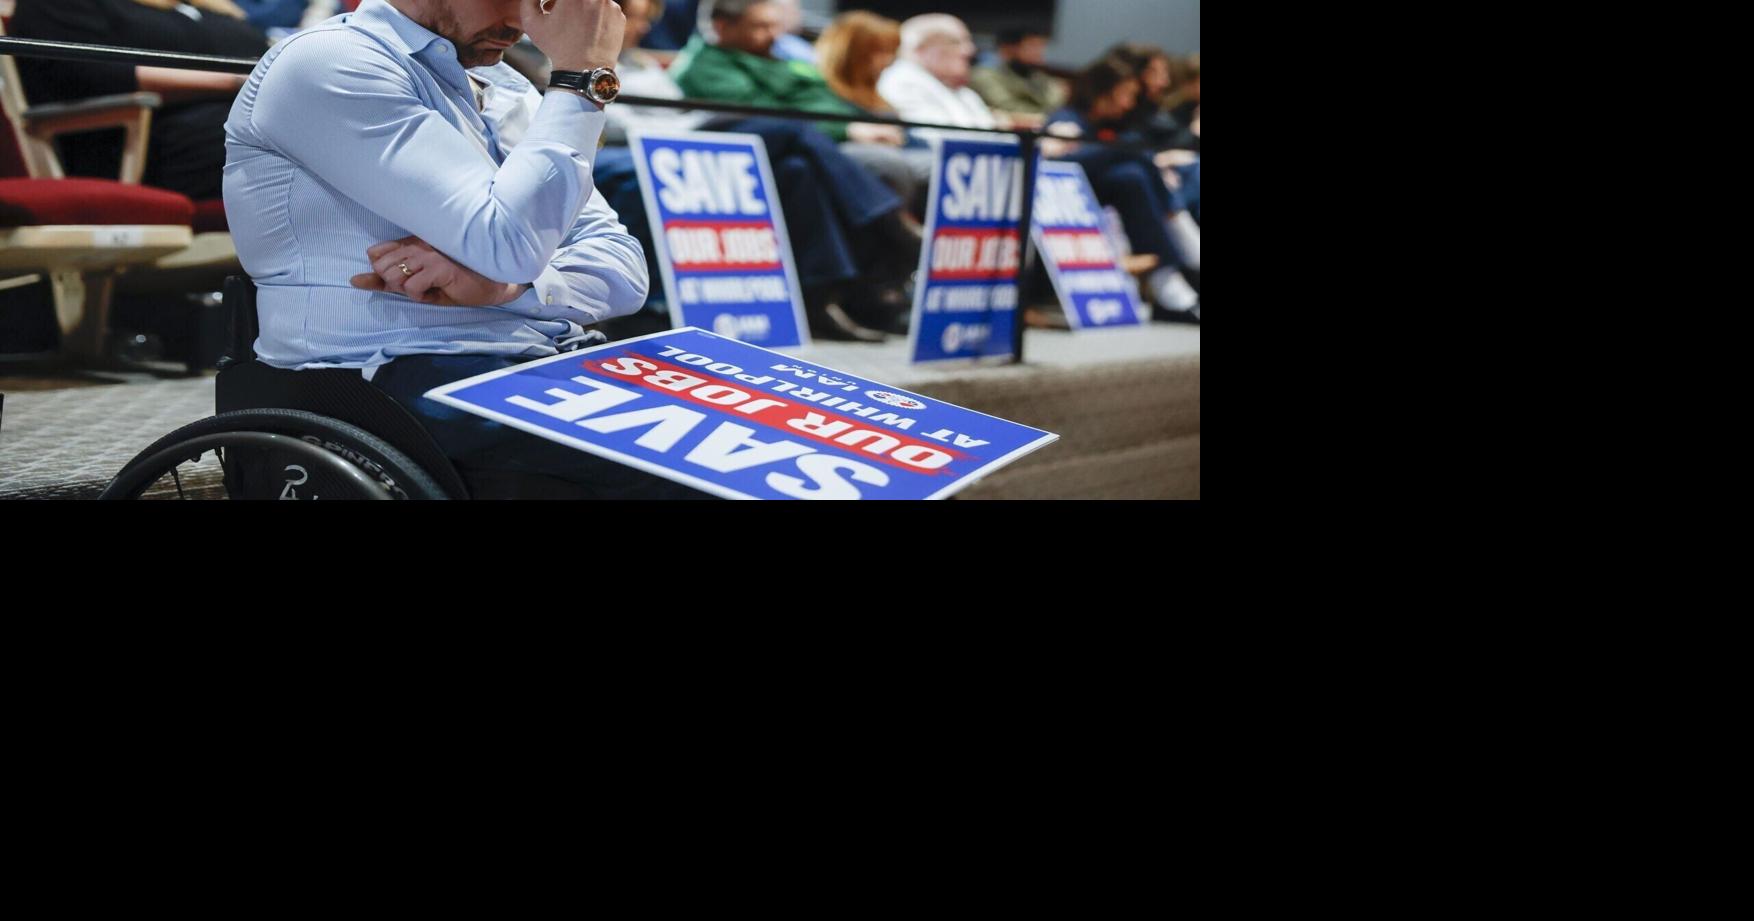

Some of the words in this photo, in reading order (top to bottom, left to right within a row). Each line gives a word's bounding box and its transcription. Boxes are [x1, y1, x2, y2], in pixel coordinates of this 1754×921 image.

[650, 147, 766, 214] SAVE
[601, 357, 788, 414] JOBS
[657, 346, 917, 430] WHIRLPOOL
[770, 364, 859, 391] IAM
[505, 376, 890, 500] SAVE
[786, 412, 953, 469] OUR
[921, 428, 991, 448] AT
